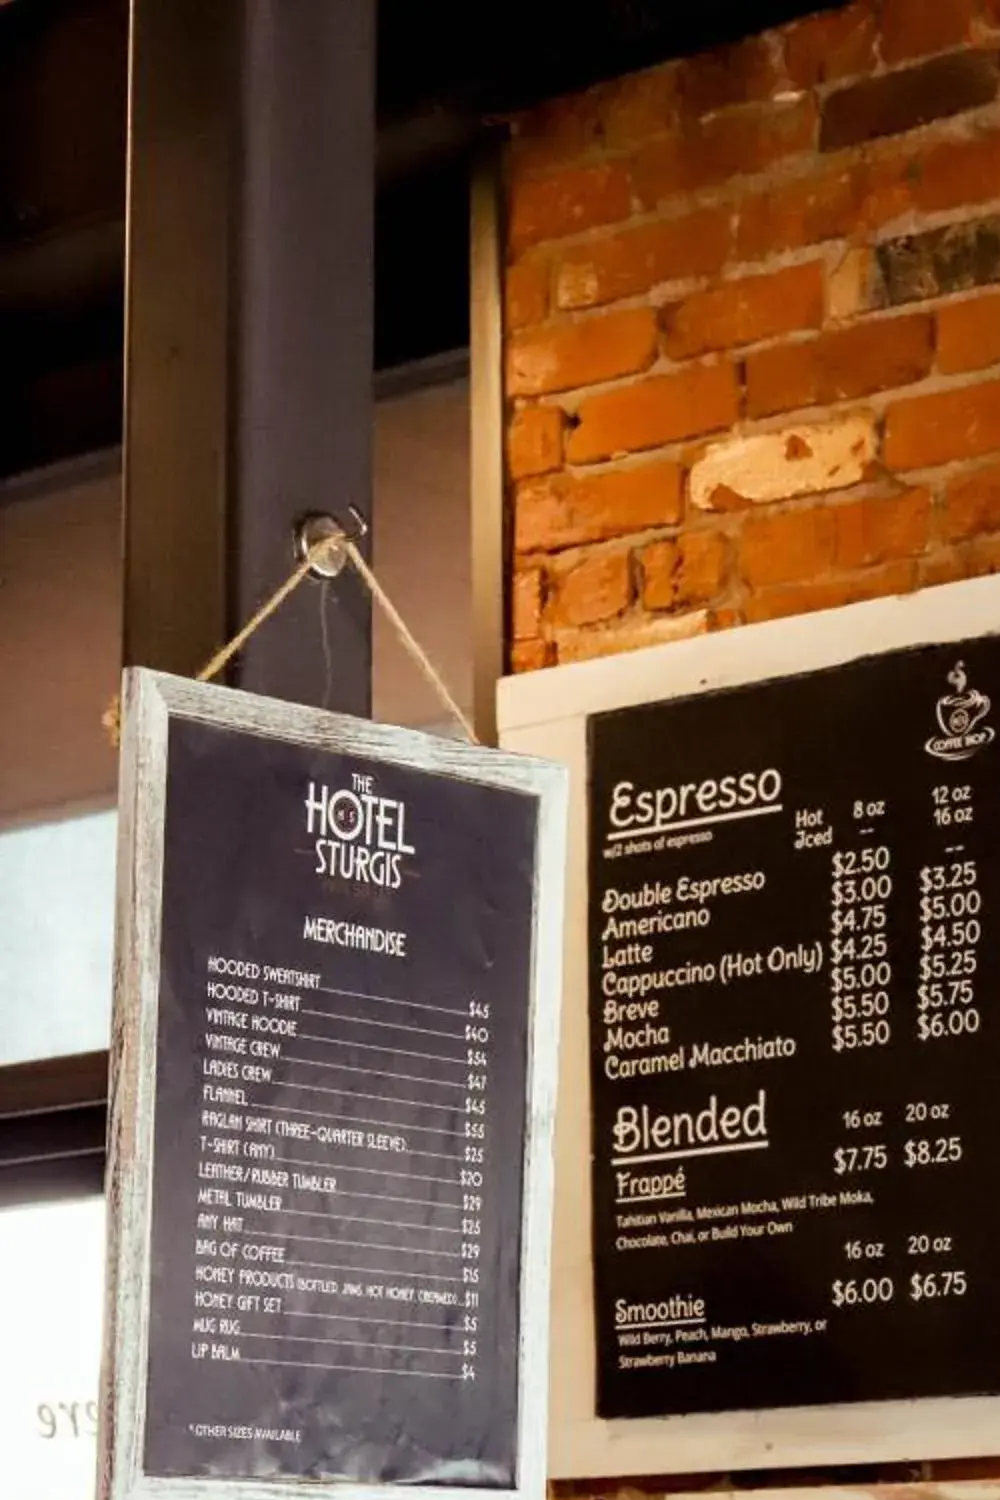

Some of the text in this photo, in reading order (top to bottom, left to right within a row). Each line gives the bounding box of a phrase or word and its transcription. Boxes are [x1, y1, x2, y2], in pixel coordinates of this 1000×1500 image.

[351, 773, 374, 795] THE
[609, 768, 783, 832] Espresso
[931, 785, 971, 805] 12 oz
[304, 781, 416, 858] HOTEL
[795, 808, 824, 829] Hot
[853, 800, 886, 819] 8 oz
[315, 835, 402, 889] STURGIS
[601, 871, 766, 915] Double Espresso
[919, 889, 982, 924] $5.00
[303, 916, 407, 957] MERCHANDISE
[601, 908, 711, 942] Americano
[920, 919, 981, 953] $4.50
[207, 956, 261, 980] HOODED
[601, 943, 653, 969] Latte
[601, 941, 824, 999] Cappuccino (Hot Only)
[602, 999, 660, 1025] Breve
[603, 1022, 670, 1053] Mocha
[604, 1035, 797, 1081] Caramel Macchiato
[612, 1089, 767, 1153] Blended
[615, 1166, 687, 1200] Frappé
[615, 1294, 705, 1325] Smoothie
